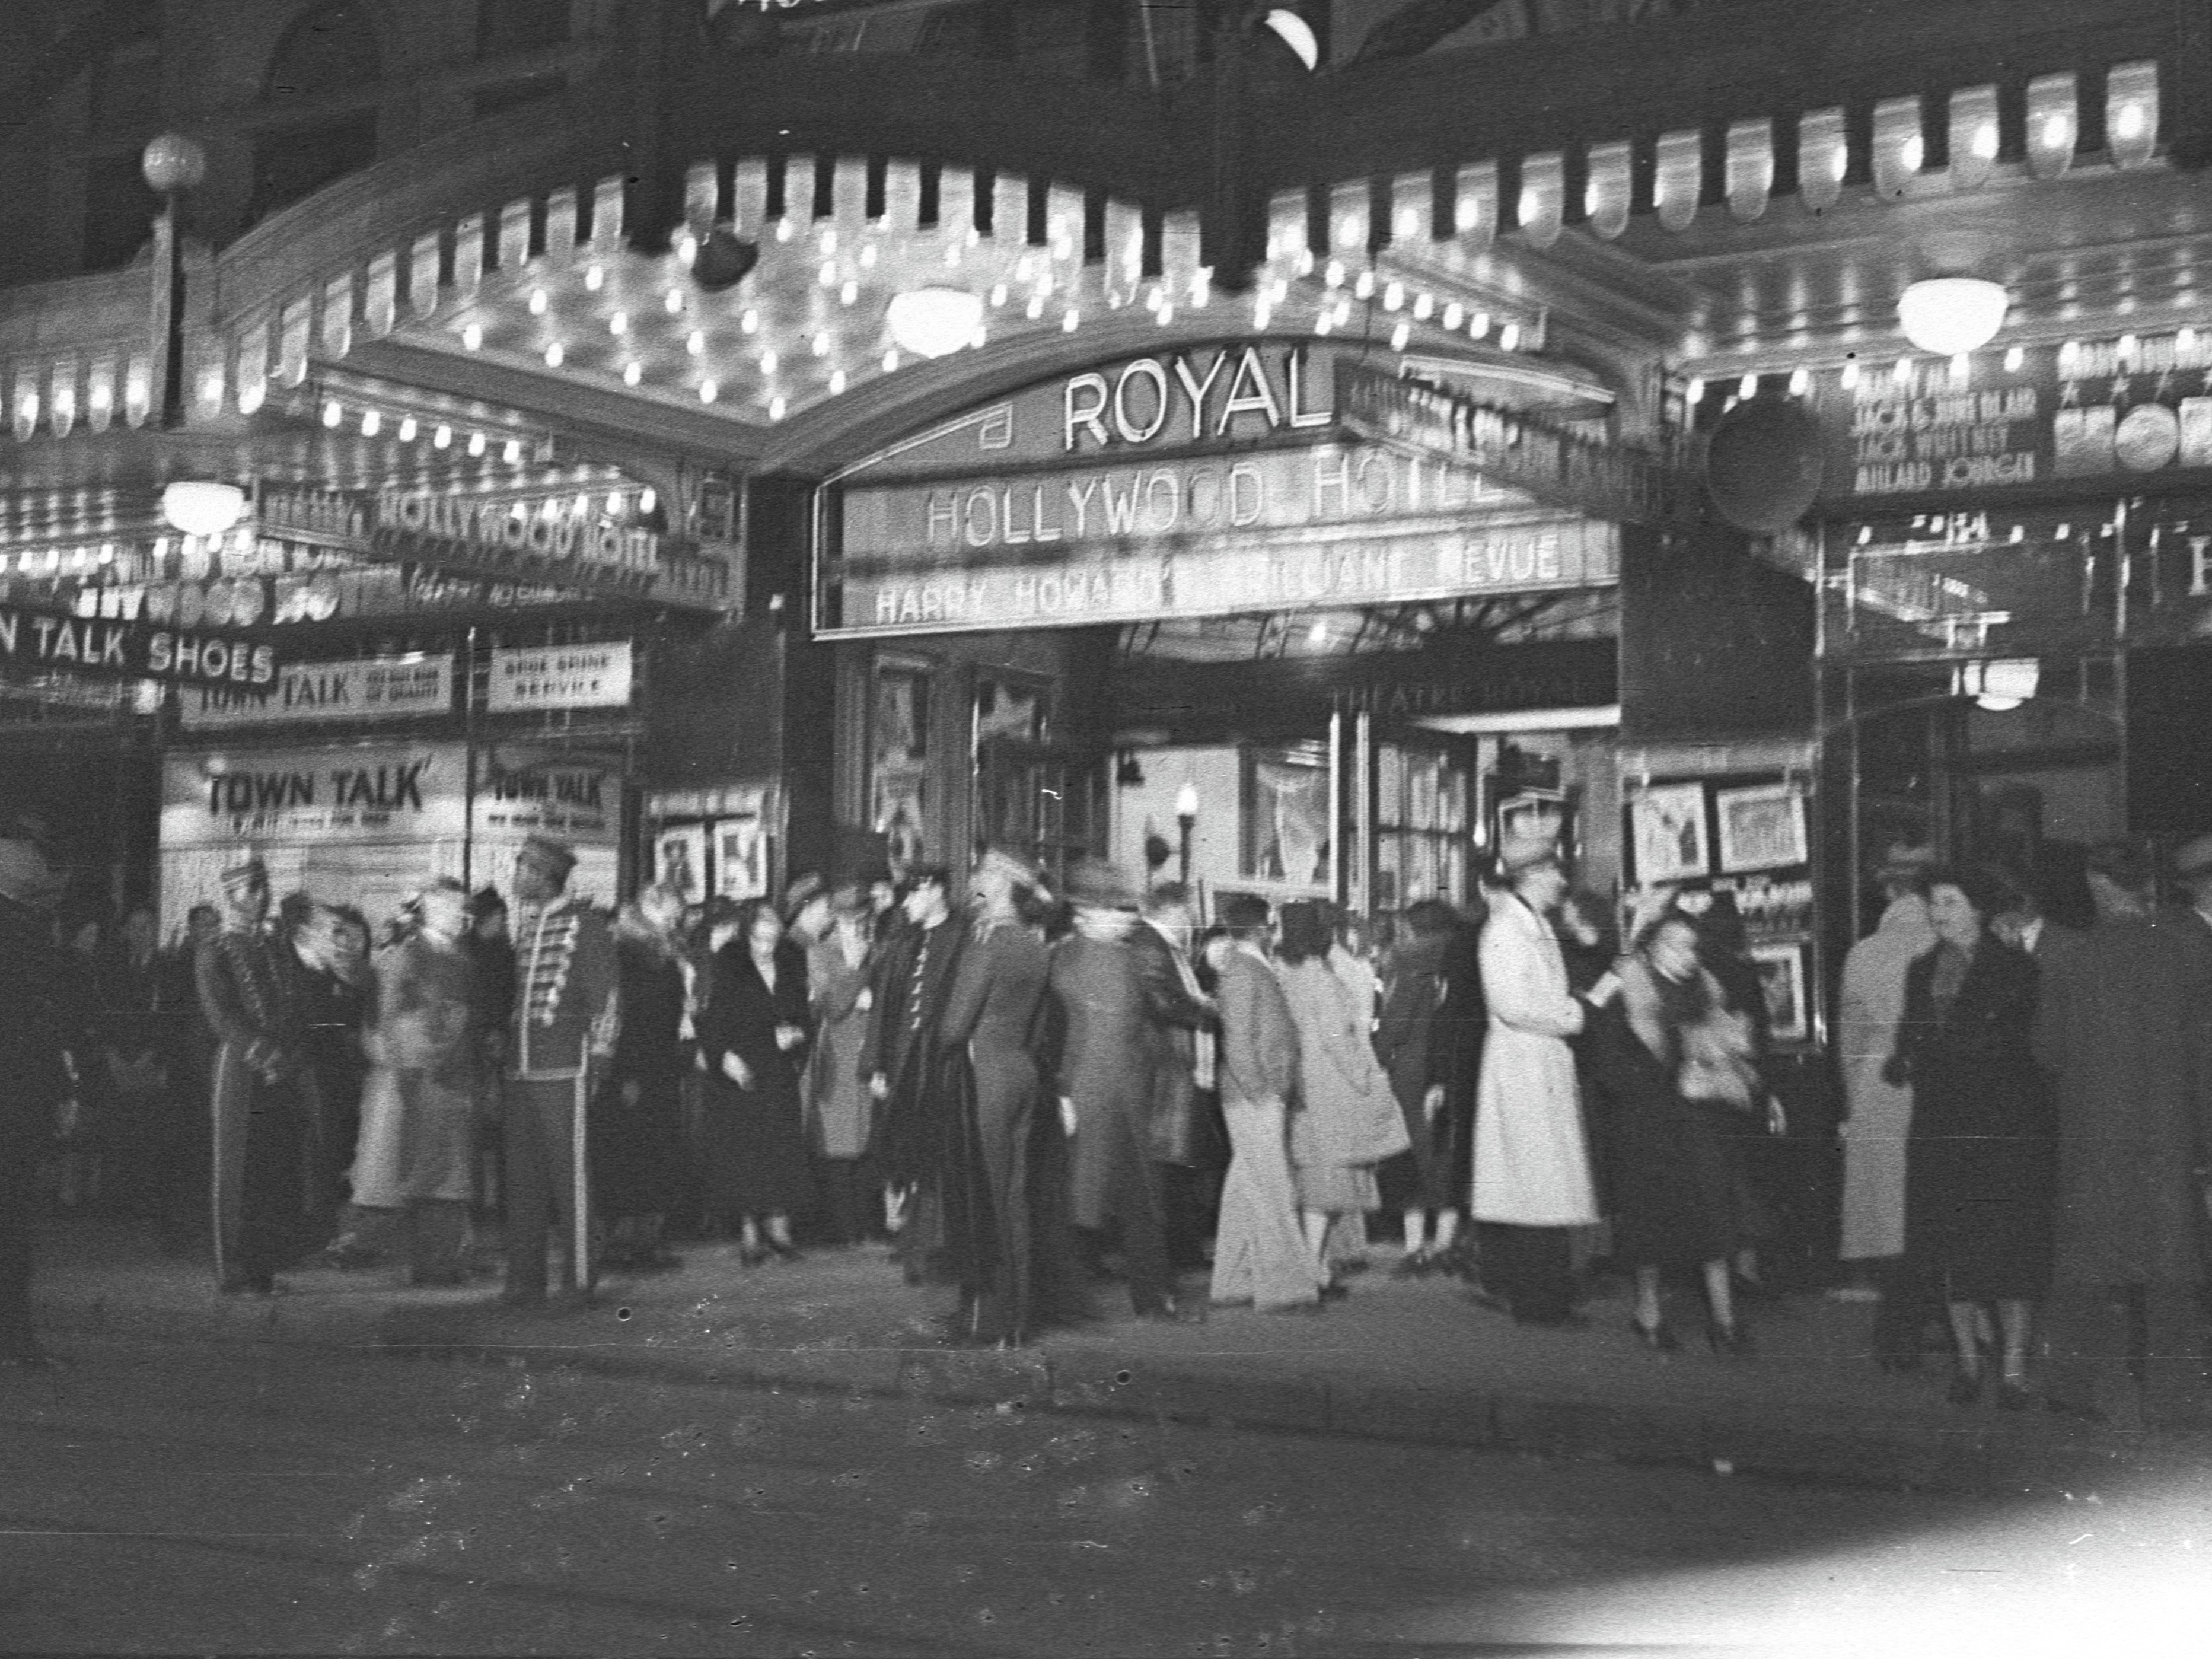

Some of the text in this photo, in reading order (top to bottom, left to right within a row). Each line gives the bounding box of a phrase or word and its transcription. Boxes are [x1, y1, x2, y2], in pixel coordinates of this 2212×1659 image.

[1066, 346, 1333, 450] ROYAL
[928, 462, 1263, 547] HOLLYWOOD
[876, 578, 987, 625] HARRY
[148, 632, 273, 683] SHOES
[202, 771, 313, 814] TOWN
